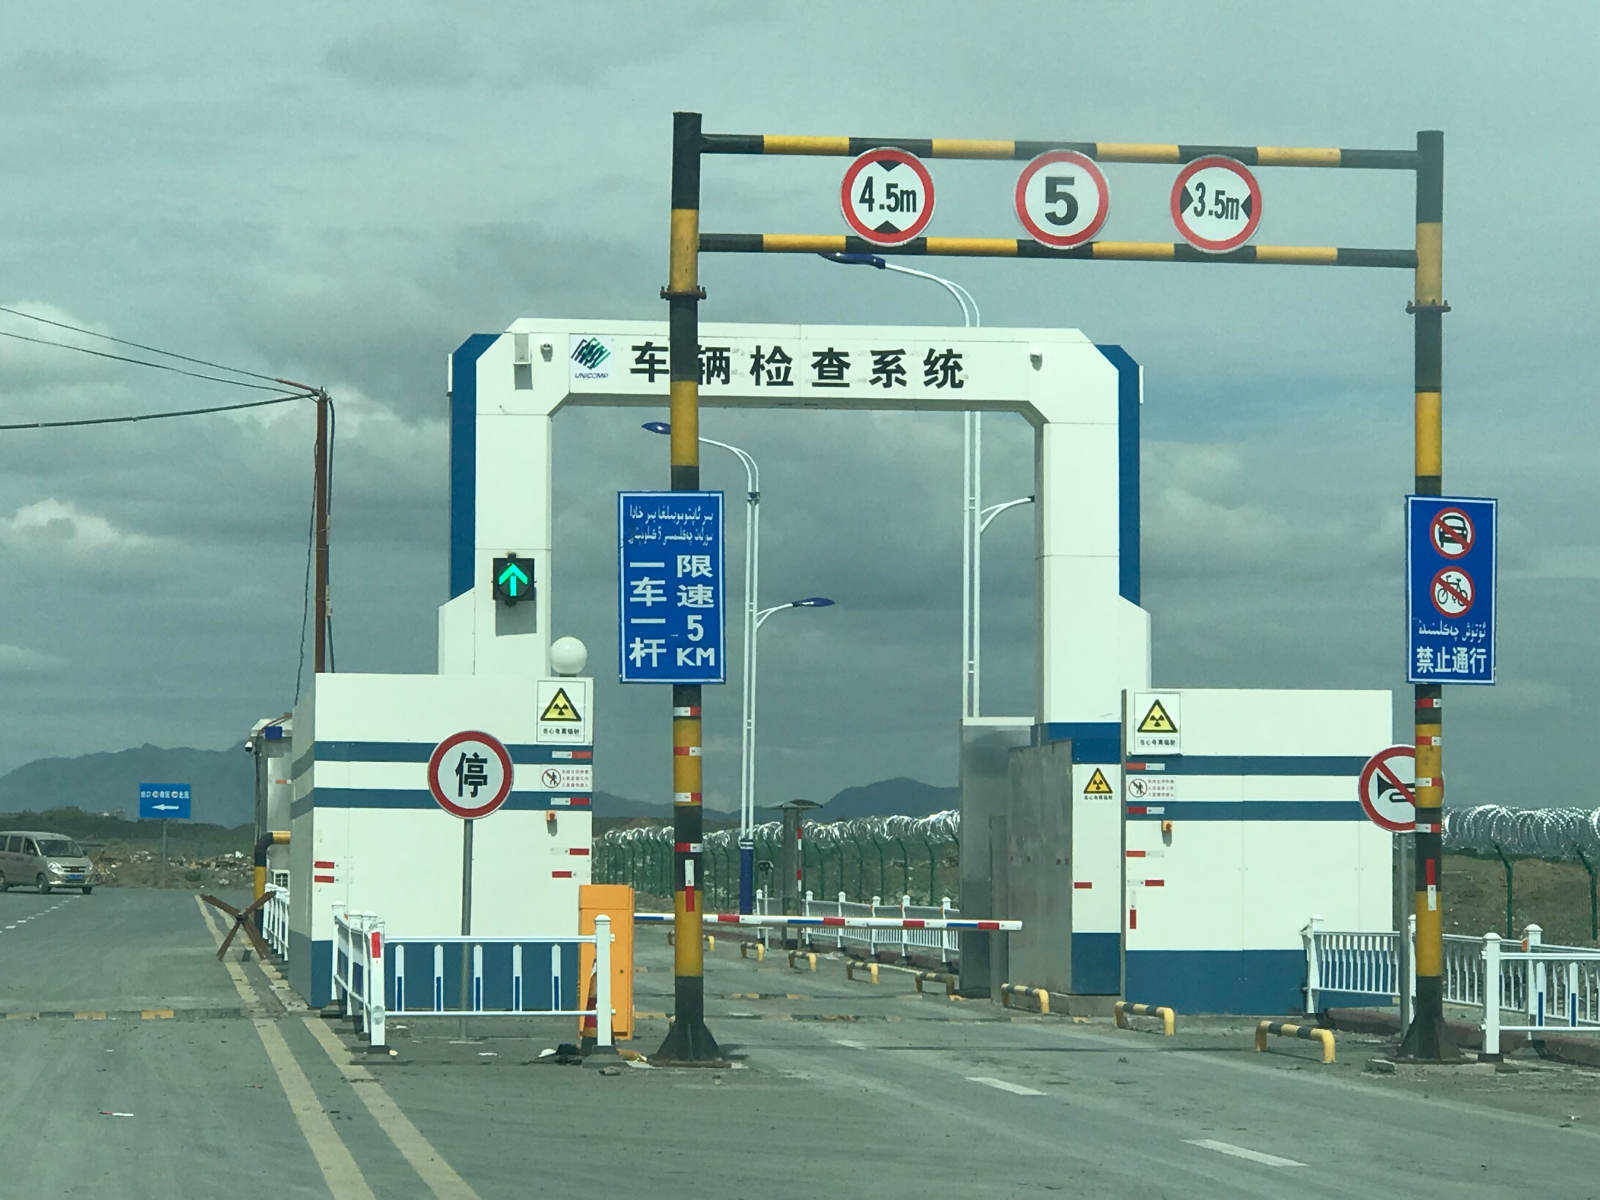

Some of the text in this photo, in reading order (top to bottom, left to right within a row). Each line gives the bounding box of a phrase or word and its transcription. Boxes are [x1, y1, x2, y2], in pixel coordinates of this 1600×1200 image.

[859, 176, 918, 213] 4.5m
[1044, 176, 1080, 226] 5
[1193, 182, 1241, 221] 3.5m
[629, 341, 965, 390] 车辆检查系统
[1416, 645, 1487, 674] 禁止通行
[455, 752, 488, 798] 停
